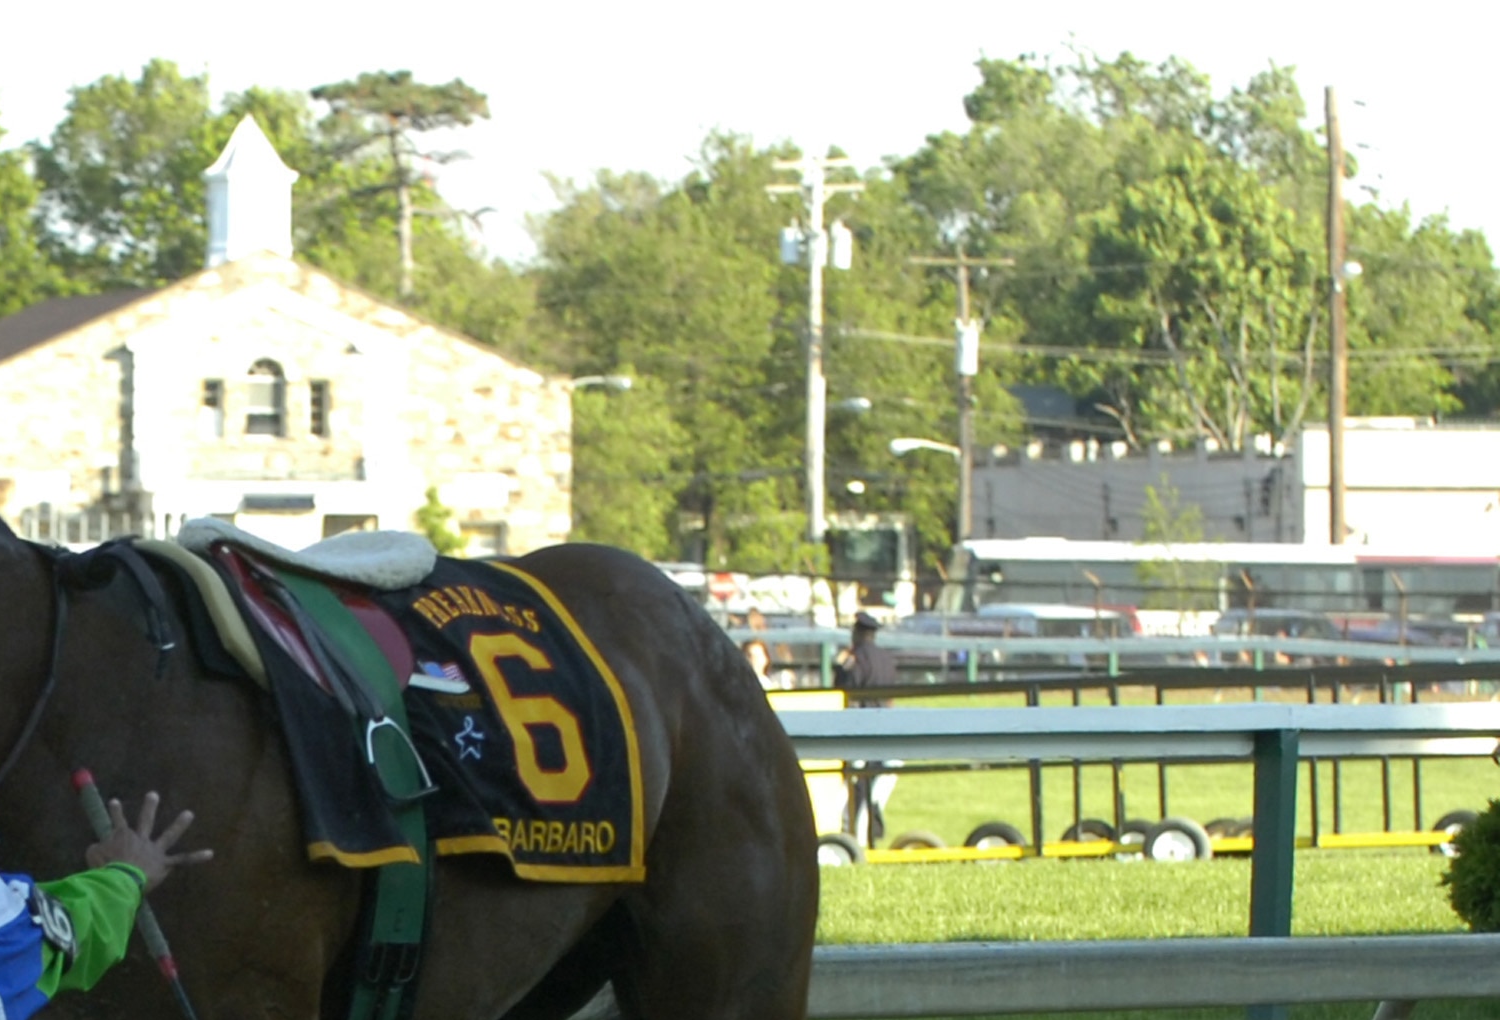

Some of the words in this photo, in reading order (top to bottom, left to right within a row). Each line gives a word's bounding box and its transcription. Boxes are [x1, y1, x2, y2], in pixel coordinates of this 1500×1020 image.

[413, 585, 540, 631] PREAKNSS
[470, 632, 591, 803] 6
[491, 817, 616, 854] BARBARO
